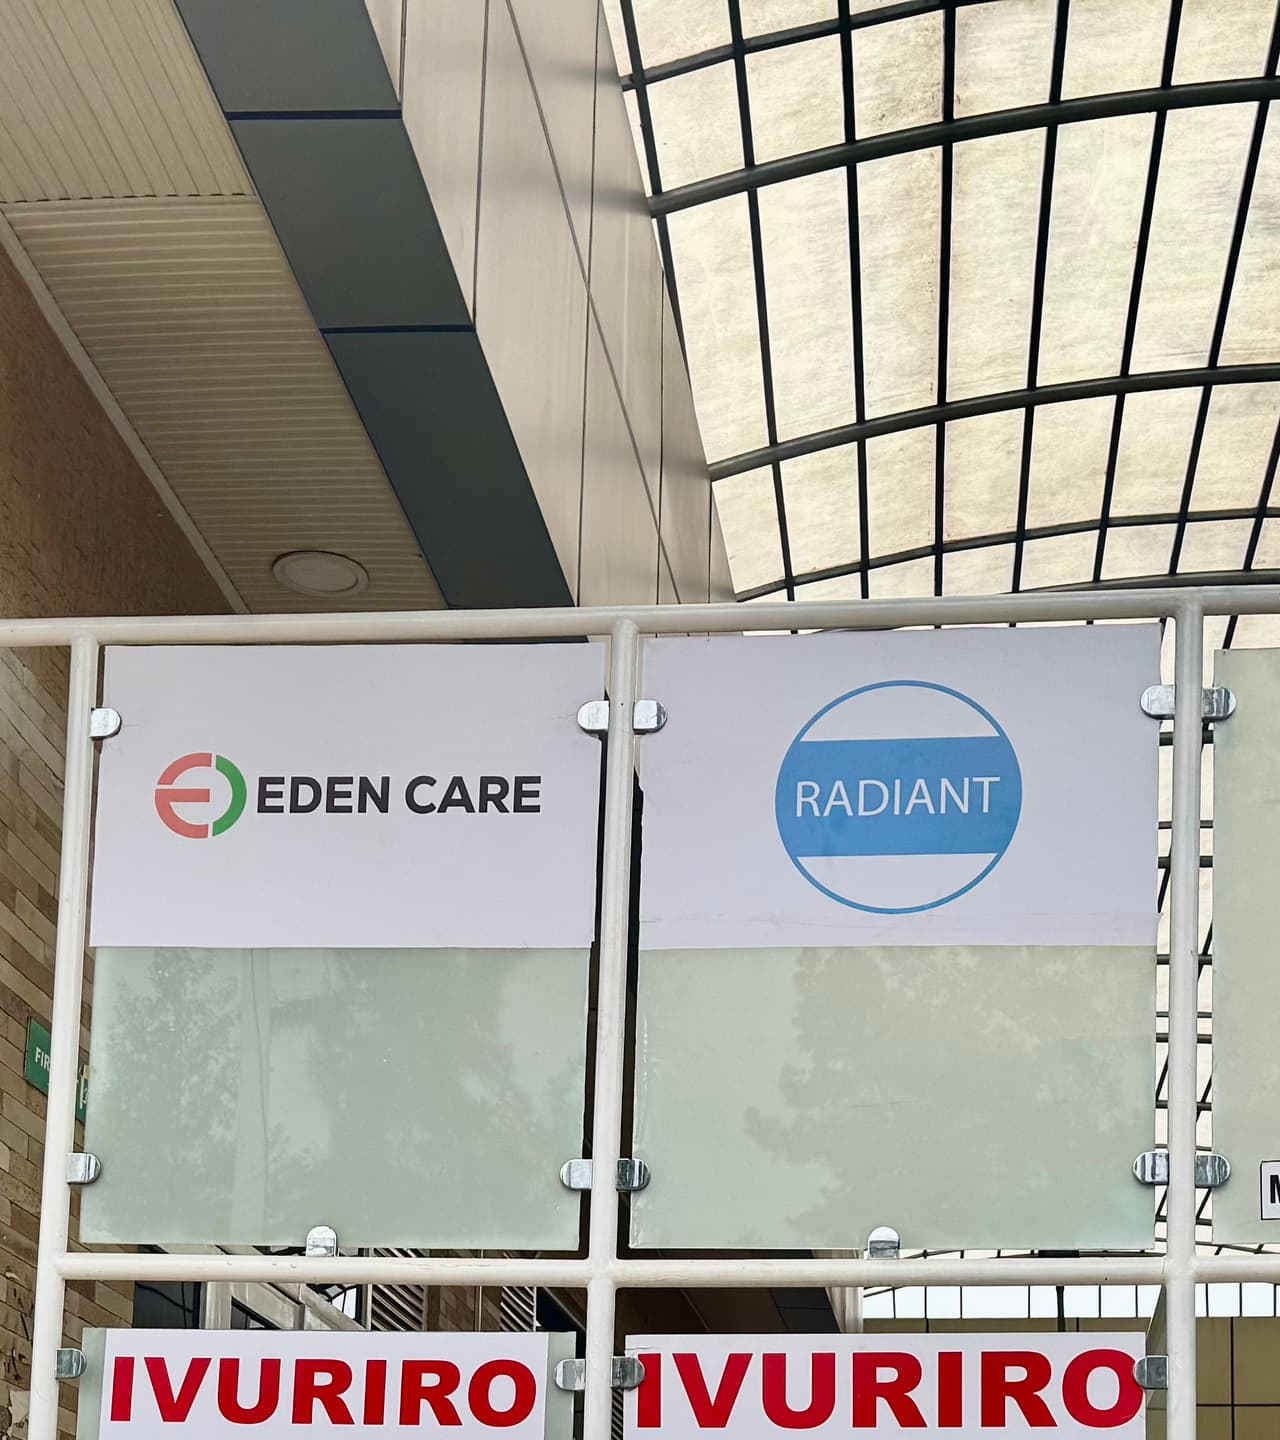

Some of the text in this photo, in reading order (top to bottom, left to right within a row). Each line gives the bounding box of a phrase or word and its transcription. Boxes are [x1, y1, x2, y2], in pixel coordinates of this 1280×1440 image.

[257, 775, 543, 814] EDEN CARE
[795, 775, 1001, 817] RADIANT
[110, 1356, 537, 1428] IVURIRO
[638, 1349, 1144, 1429] IVURIRO
